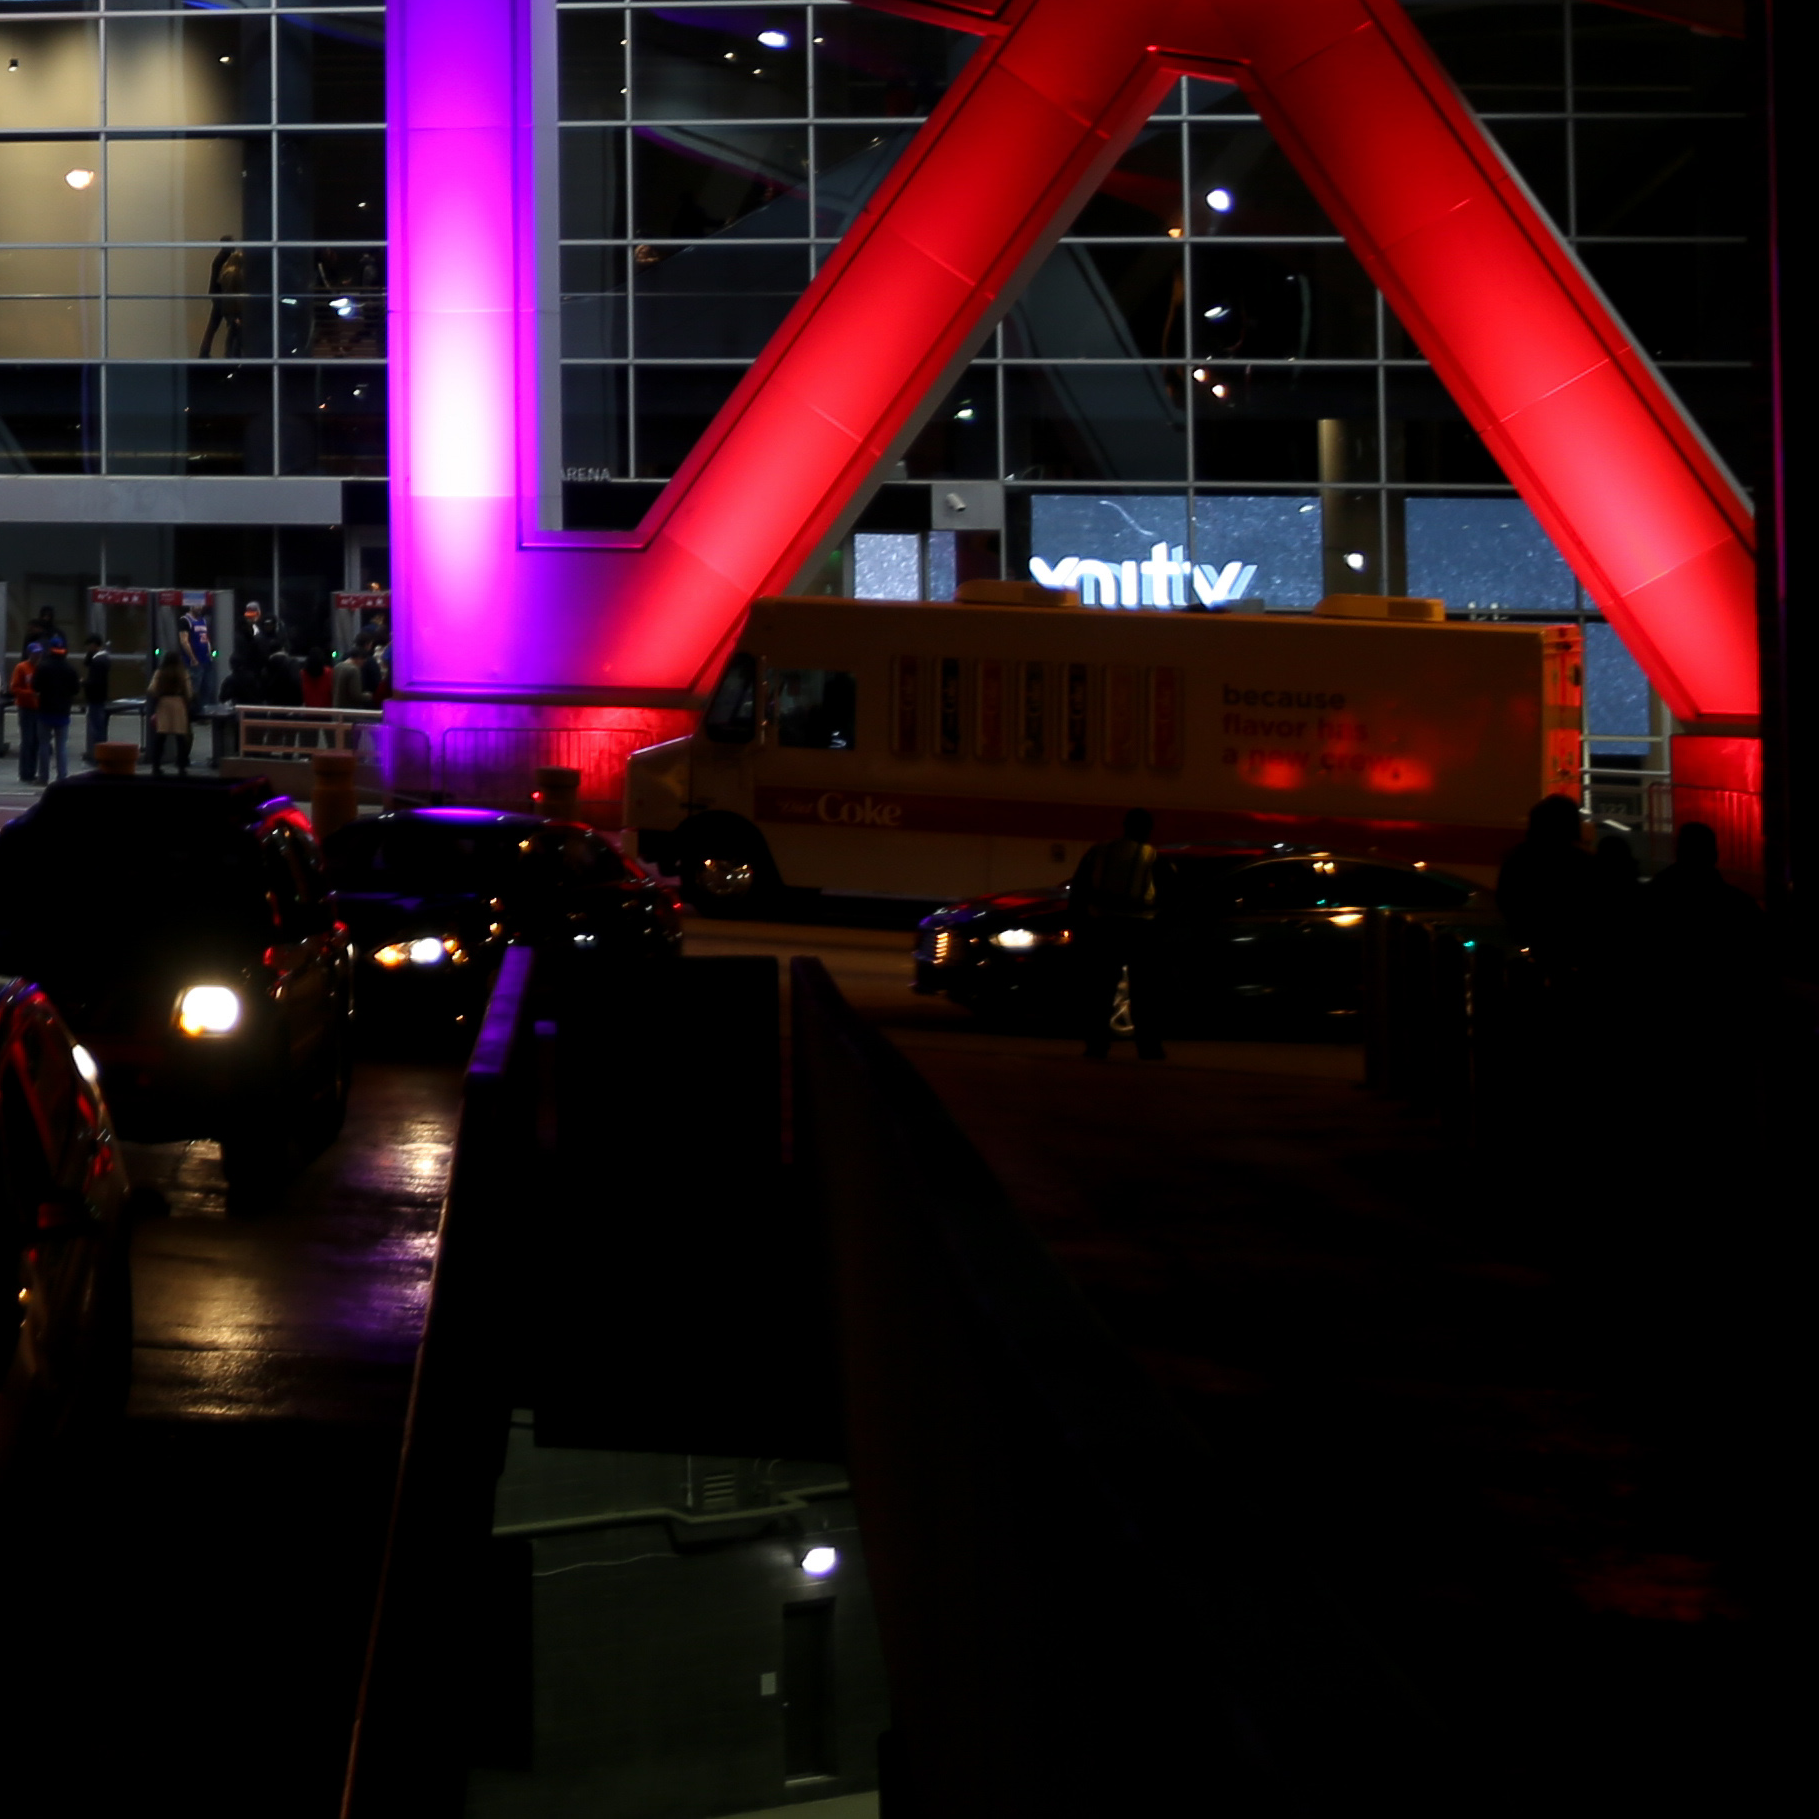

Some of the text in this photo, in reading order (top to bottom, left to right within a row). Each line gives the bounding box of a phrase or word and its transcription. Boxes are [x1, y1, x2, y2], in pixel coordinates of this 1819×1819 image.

[1222, 683, 1346, 710] because
[1222, 712, 1369, 742] flavor has
[1221, 747, 1238, 765] a
[1248, 749, 1310, 769] new
[816, 792, 903, 828] Coke
